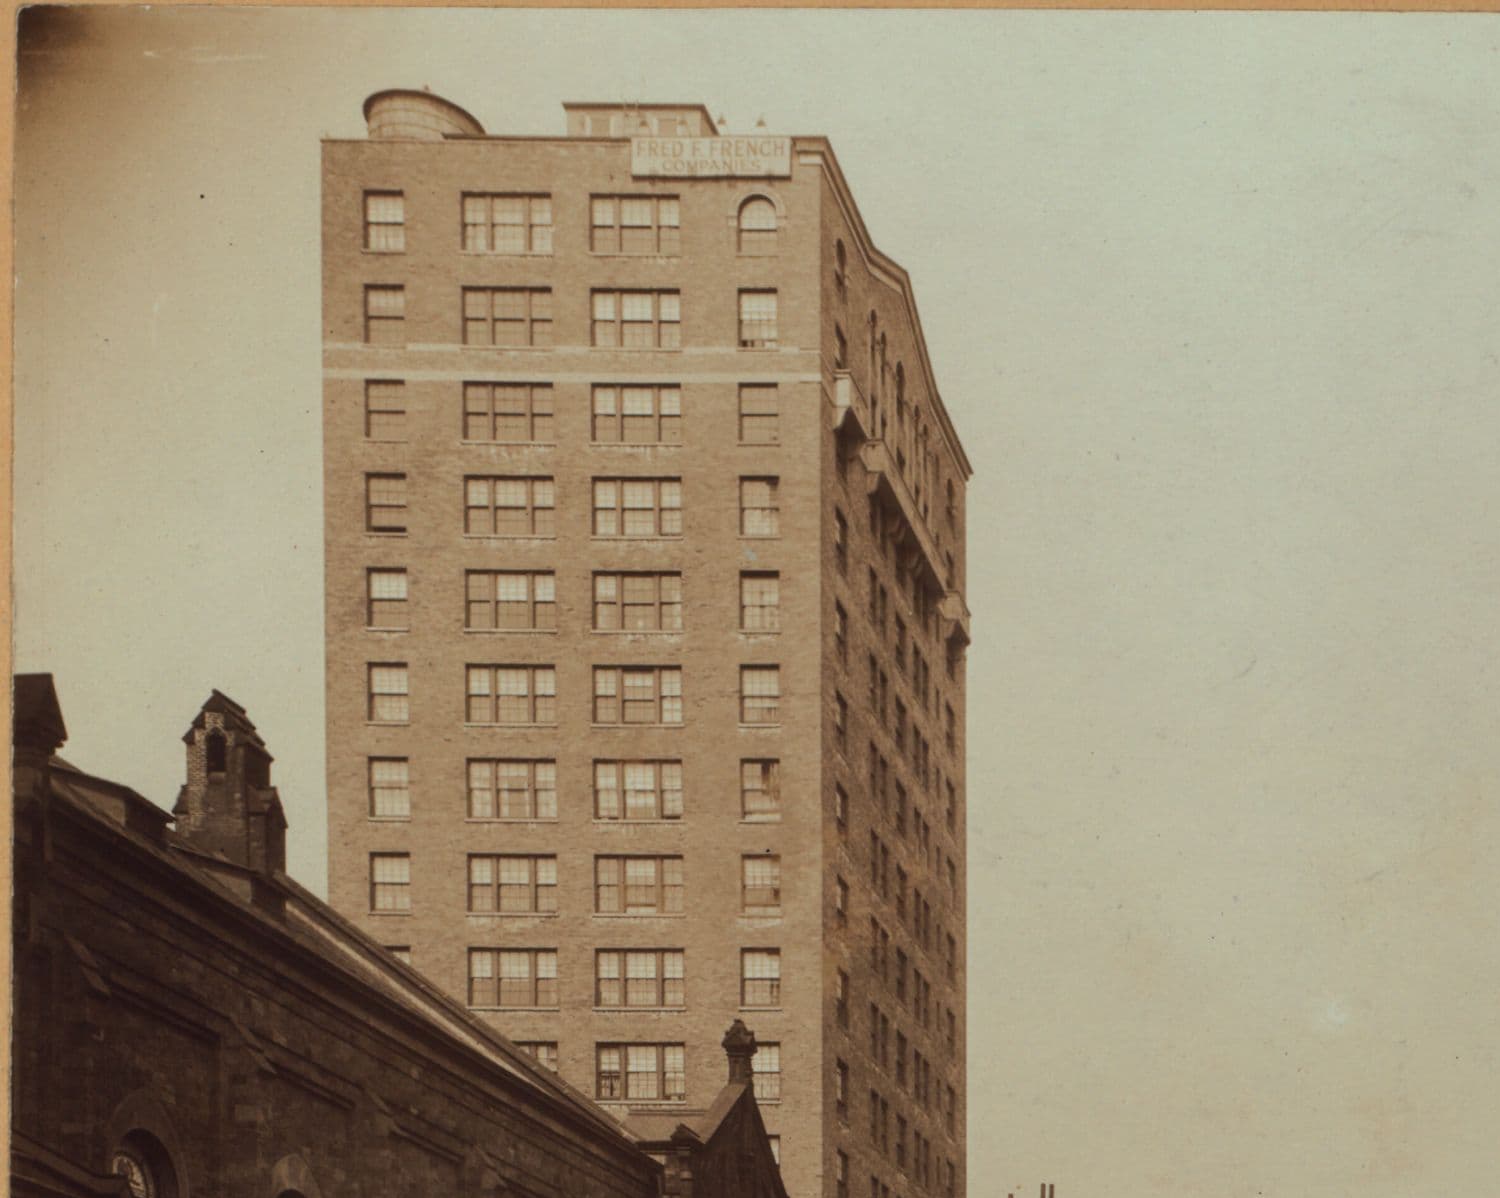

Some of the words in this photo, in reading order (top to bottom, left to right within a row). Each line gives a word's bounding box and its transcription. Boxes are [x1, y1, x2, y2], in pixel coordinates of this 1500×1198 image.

[636, 140, 684, 157] FRED
[709, 139, 785, 157] FRENCH
[662, 159, 761, 172] COMPANIES
